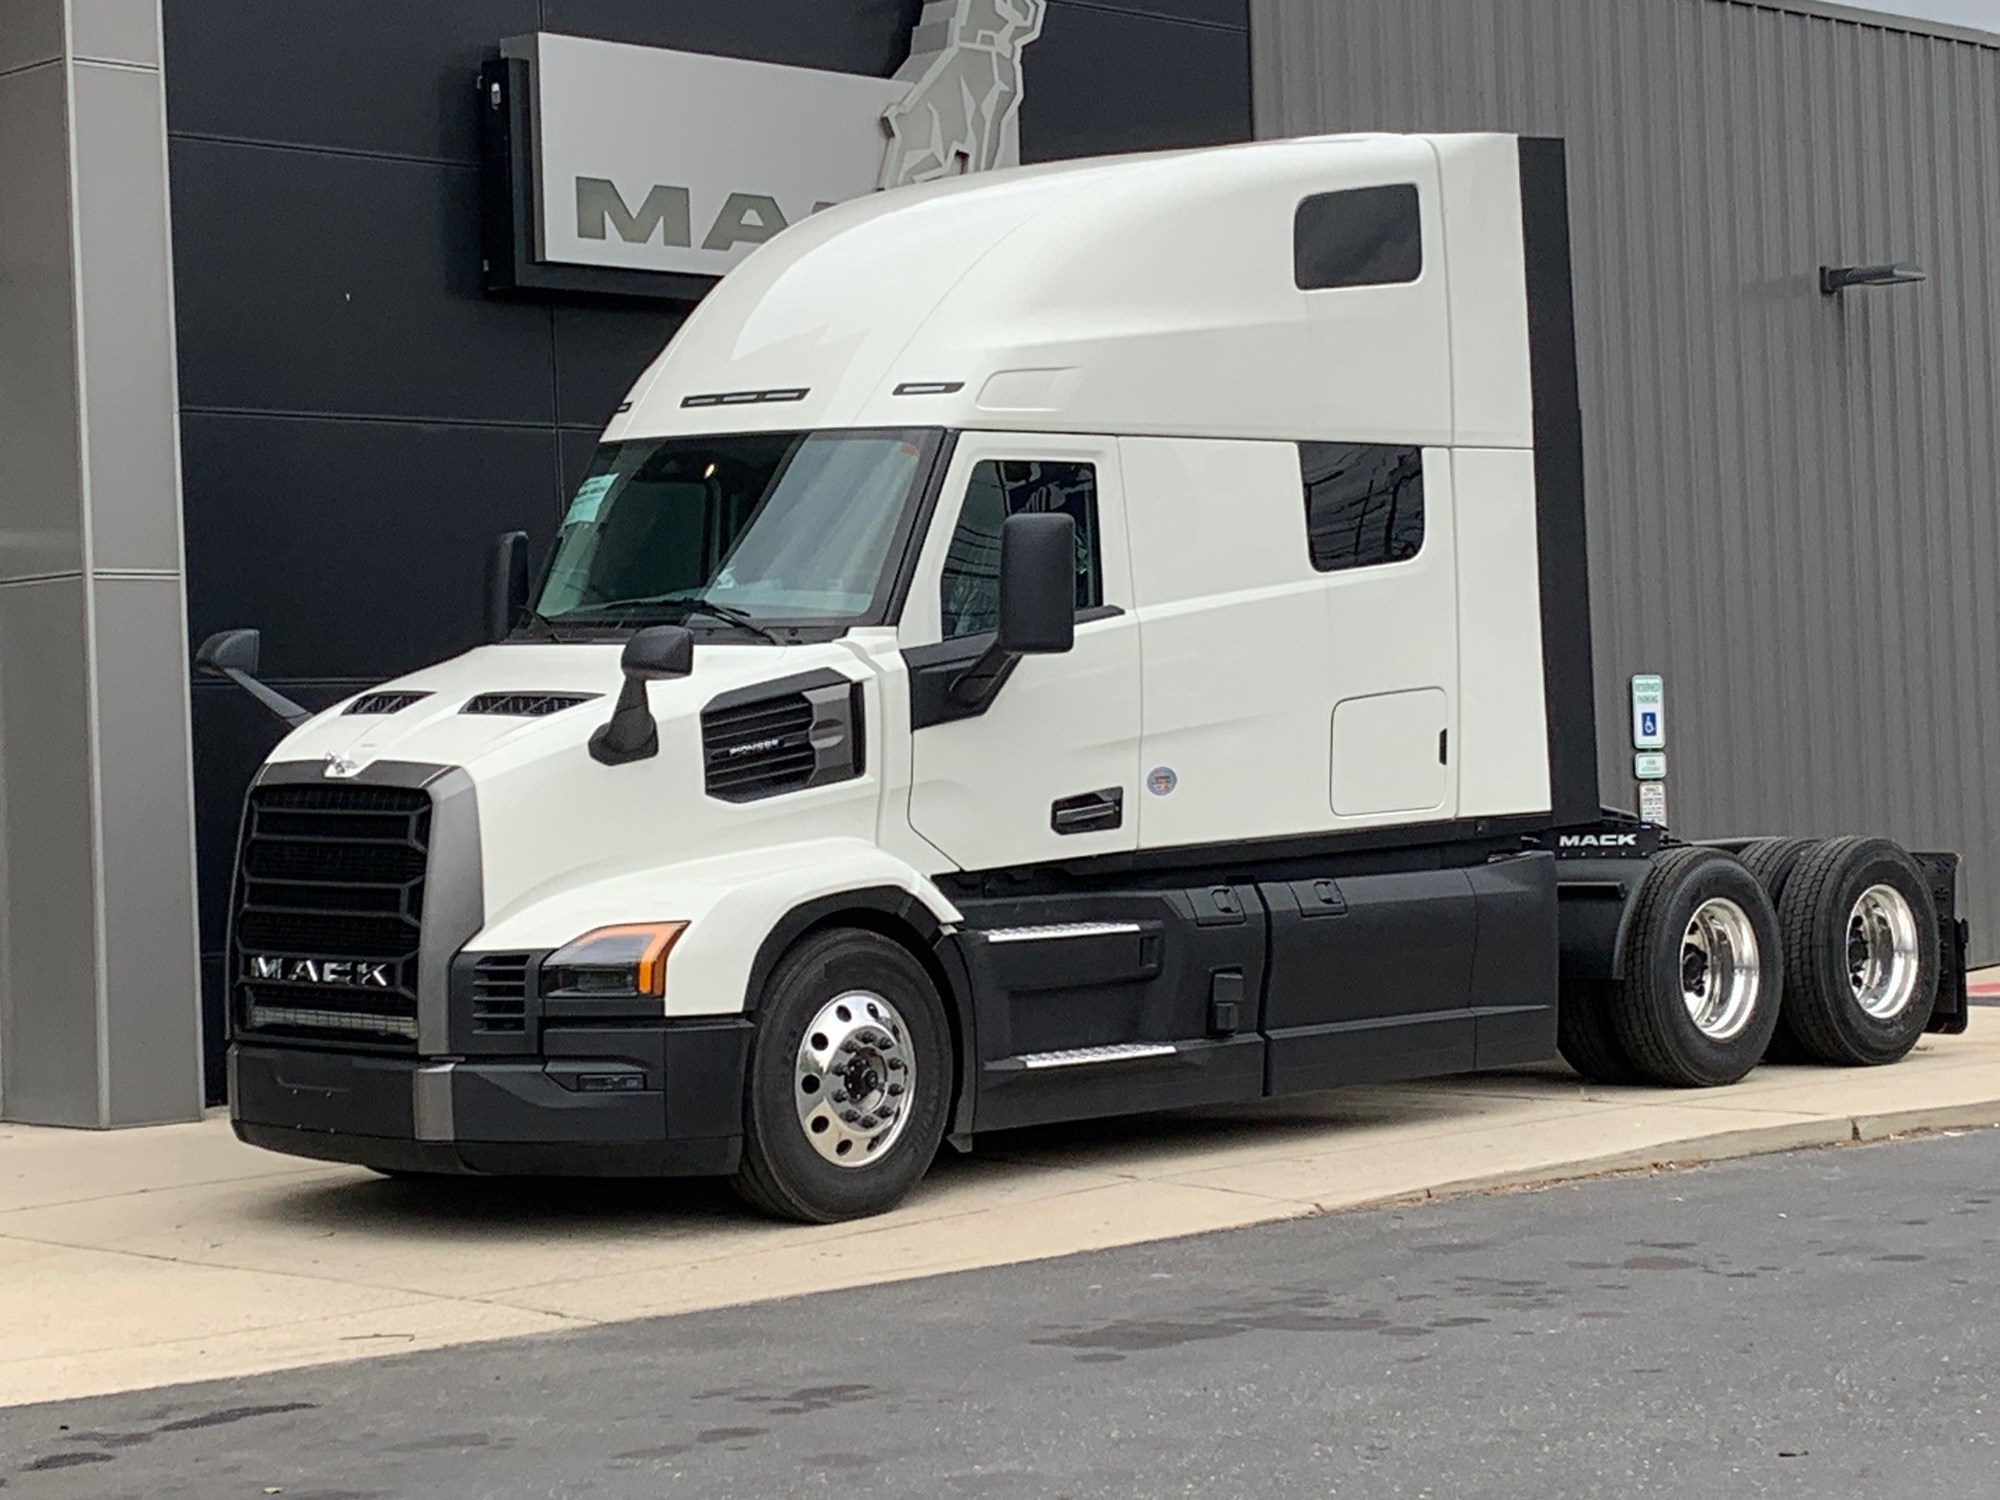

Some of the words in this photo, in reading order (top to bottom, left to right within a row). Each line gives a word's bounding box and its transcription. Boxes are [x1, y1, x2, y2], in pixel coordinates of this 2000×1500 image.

[575, 176, 837, 252] MA
[1559, 833, 1637, 848] MACK
[250, 956, 388, 987] MACK
